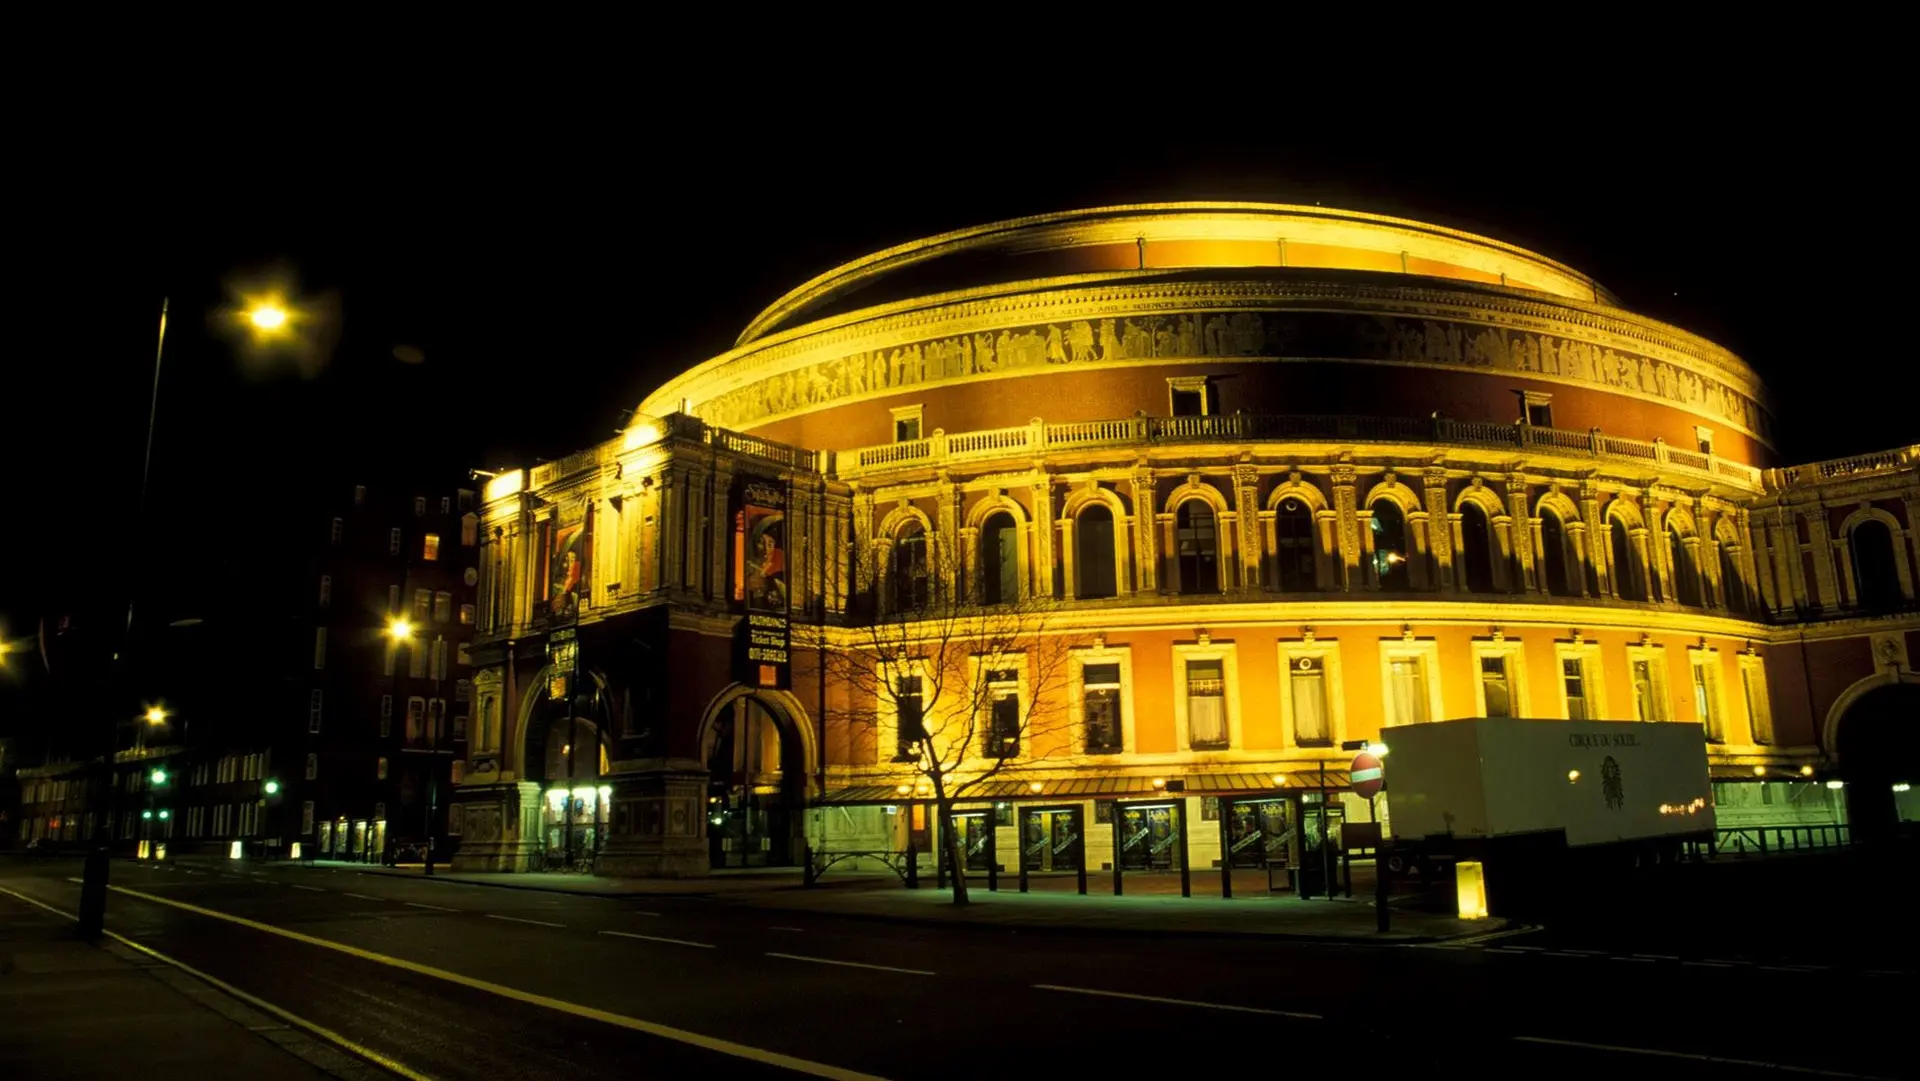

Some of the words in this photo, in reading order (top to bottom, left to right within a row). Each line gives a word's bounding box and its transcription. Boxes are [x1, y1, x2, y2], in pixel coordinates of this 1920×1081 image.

[1097, 305, 1118, 313] AND
[1569, 733, 1598, 750] CIRQUE
[1599, 733, 1612, 747] DU
[1613, 733, 1641, 747] SOLEIL
